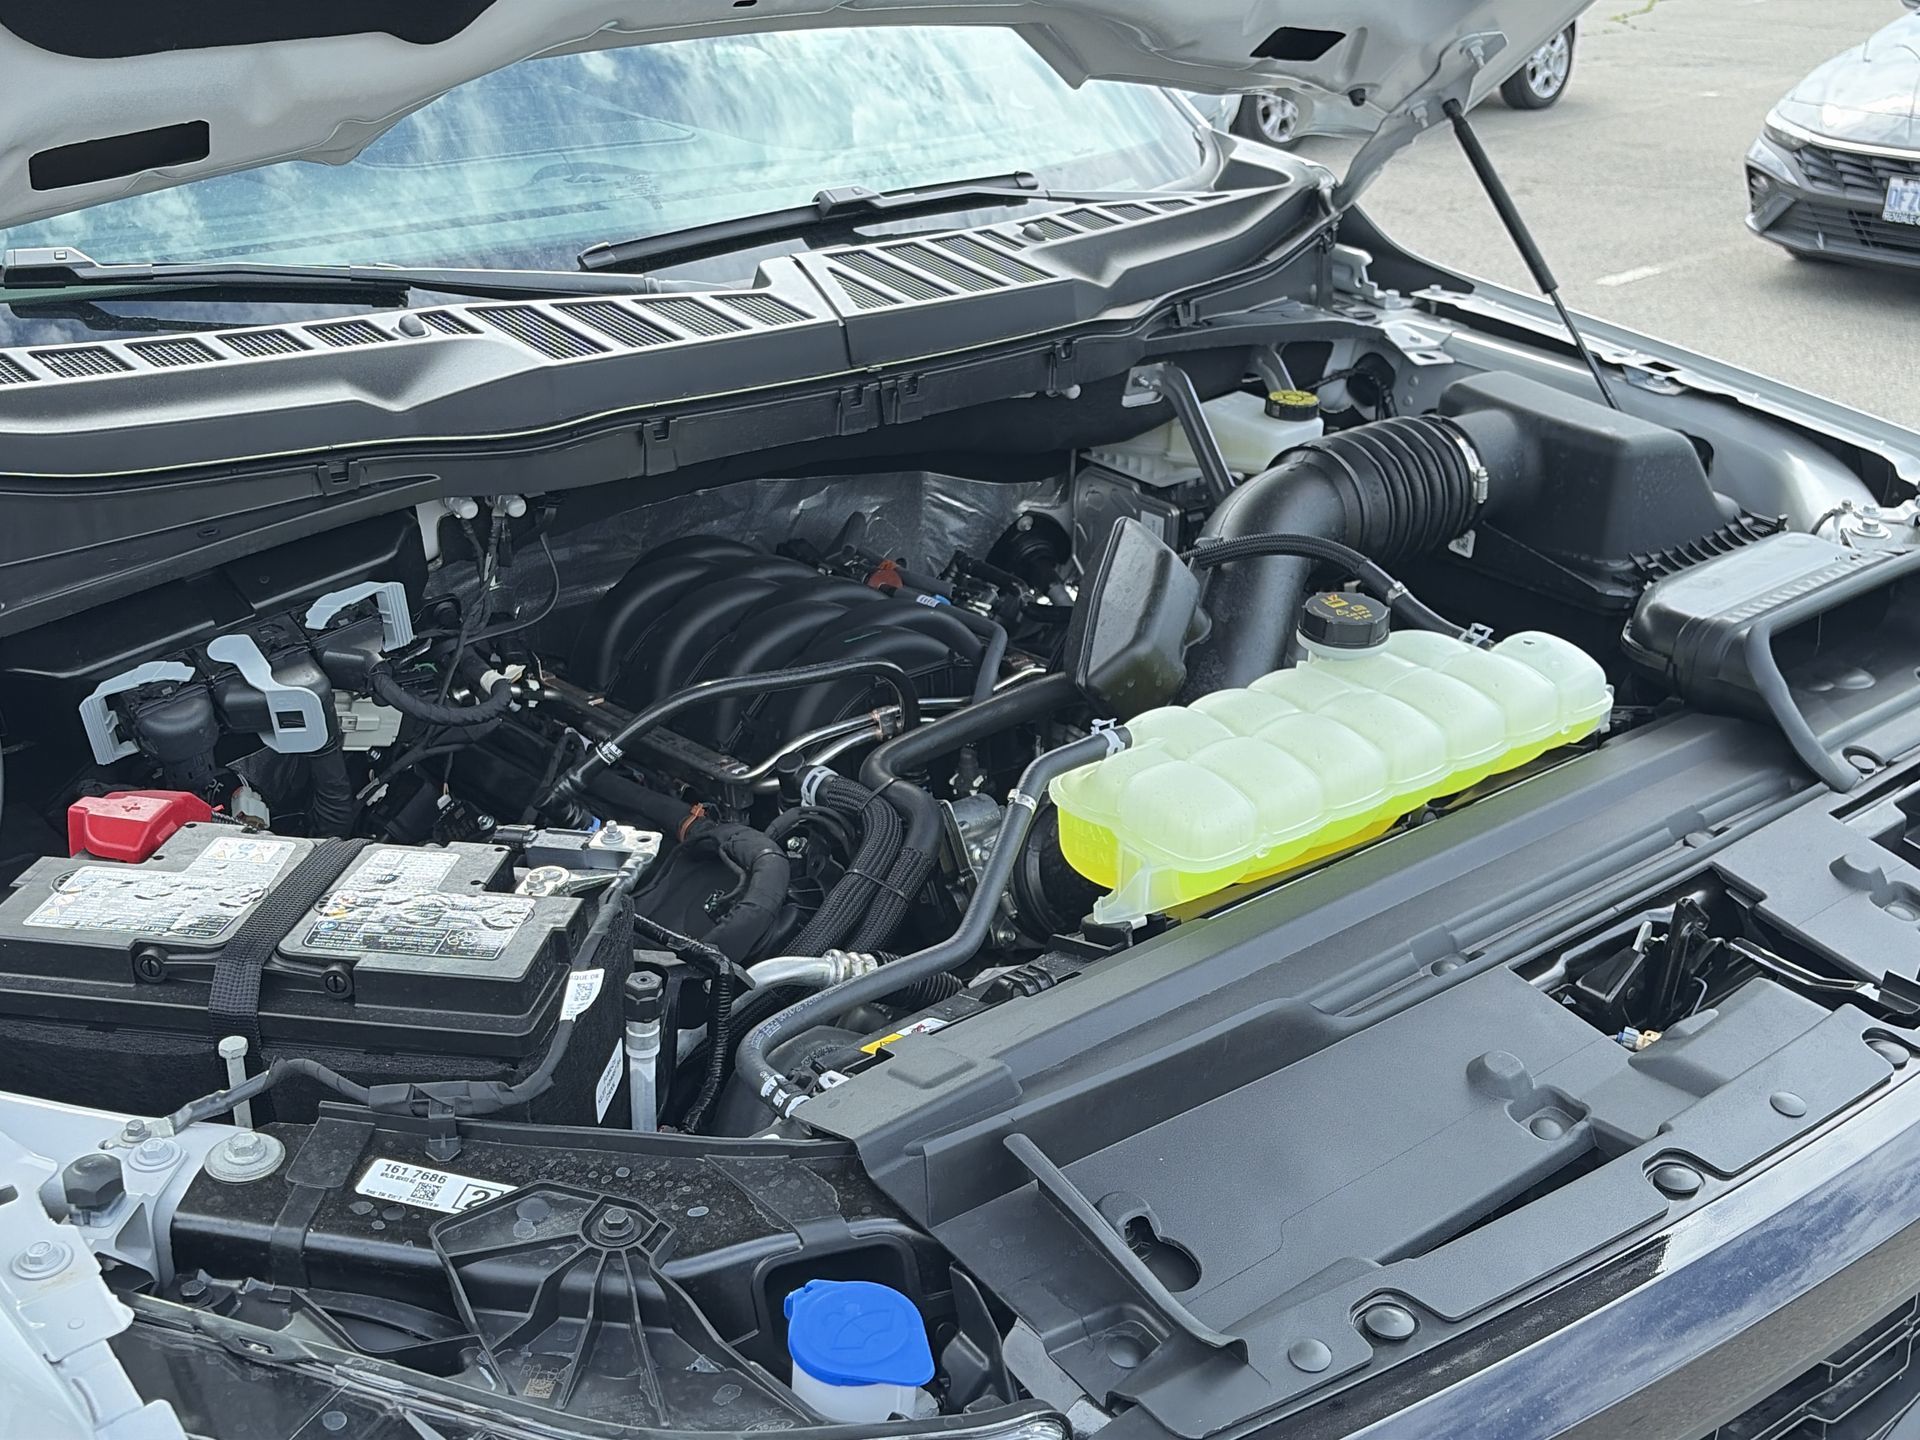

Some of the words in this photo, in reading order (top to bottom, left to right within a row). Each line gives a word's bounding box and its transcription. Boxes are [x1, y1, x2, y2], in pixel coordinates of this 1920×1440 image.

[384, 1163, 409, 1176] 161
[413, 1169, 448, 1184] 7686
[465, 1190, 491, 1211] 2
